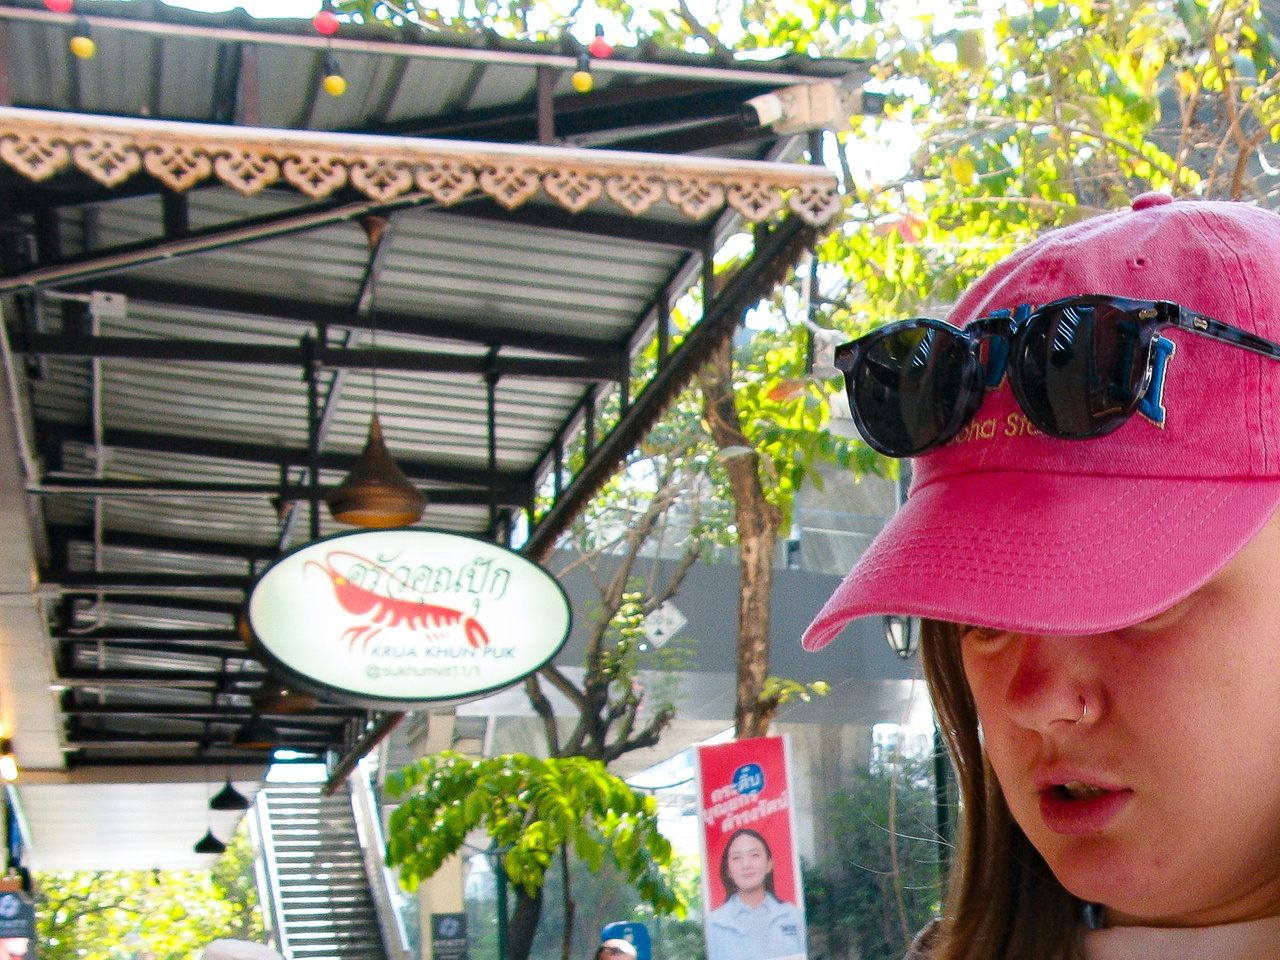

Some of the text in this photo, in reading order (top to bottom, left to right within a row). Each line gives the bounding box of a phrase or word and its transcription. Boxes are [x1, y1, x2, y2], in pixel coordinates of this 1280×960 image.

[371, 645, 517, 660] KRUA KHUN PUK
